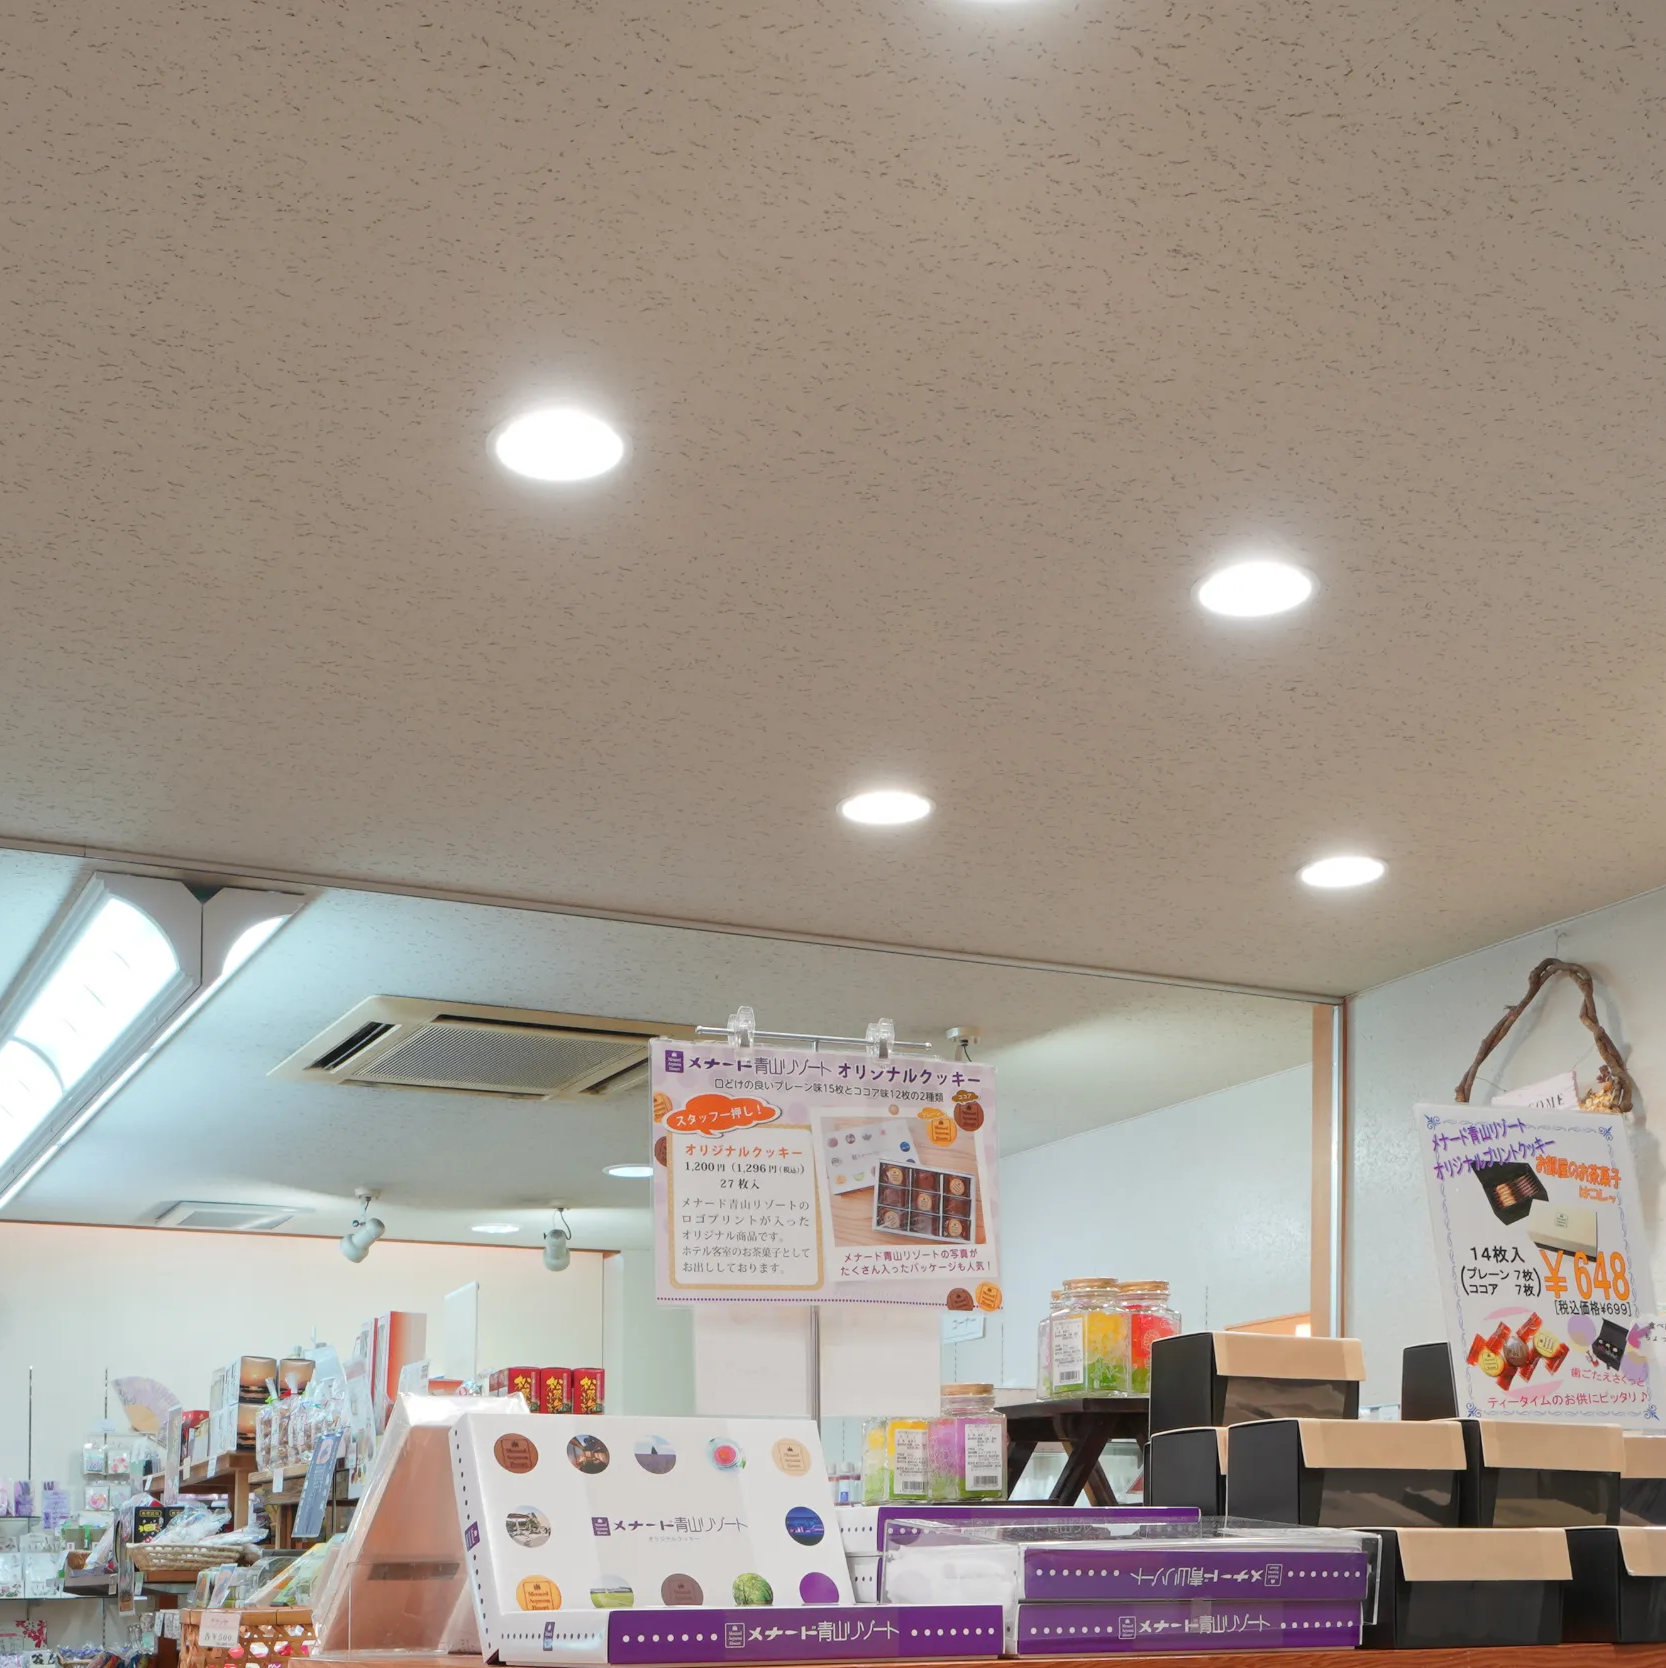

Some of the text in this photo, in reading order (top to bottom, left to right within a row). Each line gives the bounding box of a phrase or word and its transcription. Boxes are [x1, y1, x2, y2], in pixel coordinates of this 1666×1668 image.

[689, 1056, 832, 1076] メナード青山リゾート
[1432, 1118, 1526, 1152] メナード青山リゾート
[685, 1143, 802, 1158] オリジナルクッキー
[1535, 1154, 1622, 1189] お部屋のお茶菓子
[682, 1198, 809, 1210] メナード青山リゾートの
[682, 1214, 809, 1227] ロゴプリントが入った
[682, 1230, 784, 1243] オリジナル商品です。
[682, 1246, 810, 1258] ホテル客室のお茶菓子として
[844, 1248, 978, 1263] メナード青山リゾートの写真が
[1469, 1246, 1526, 1263] 14枚入
[683, 1262, 785, 1275] お出ししております。
[613, 1516, 749, 1533] メナード青山リゾート
[748, 1620, 900, 1642] メナード青山リゾート
[1138, 1613, 1271, 1634] メナード青山リゾート
